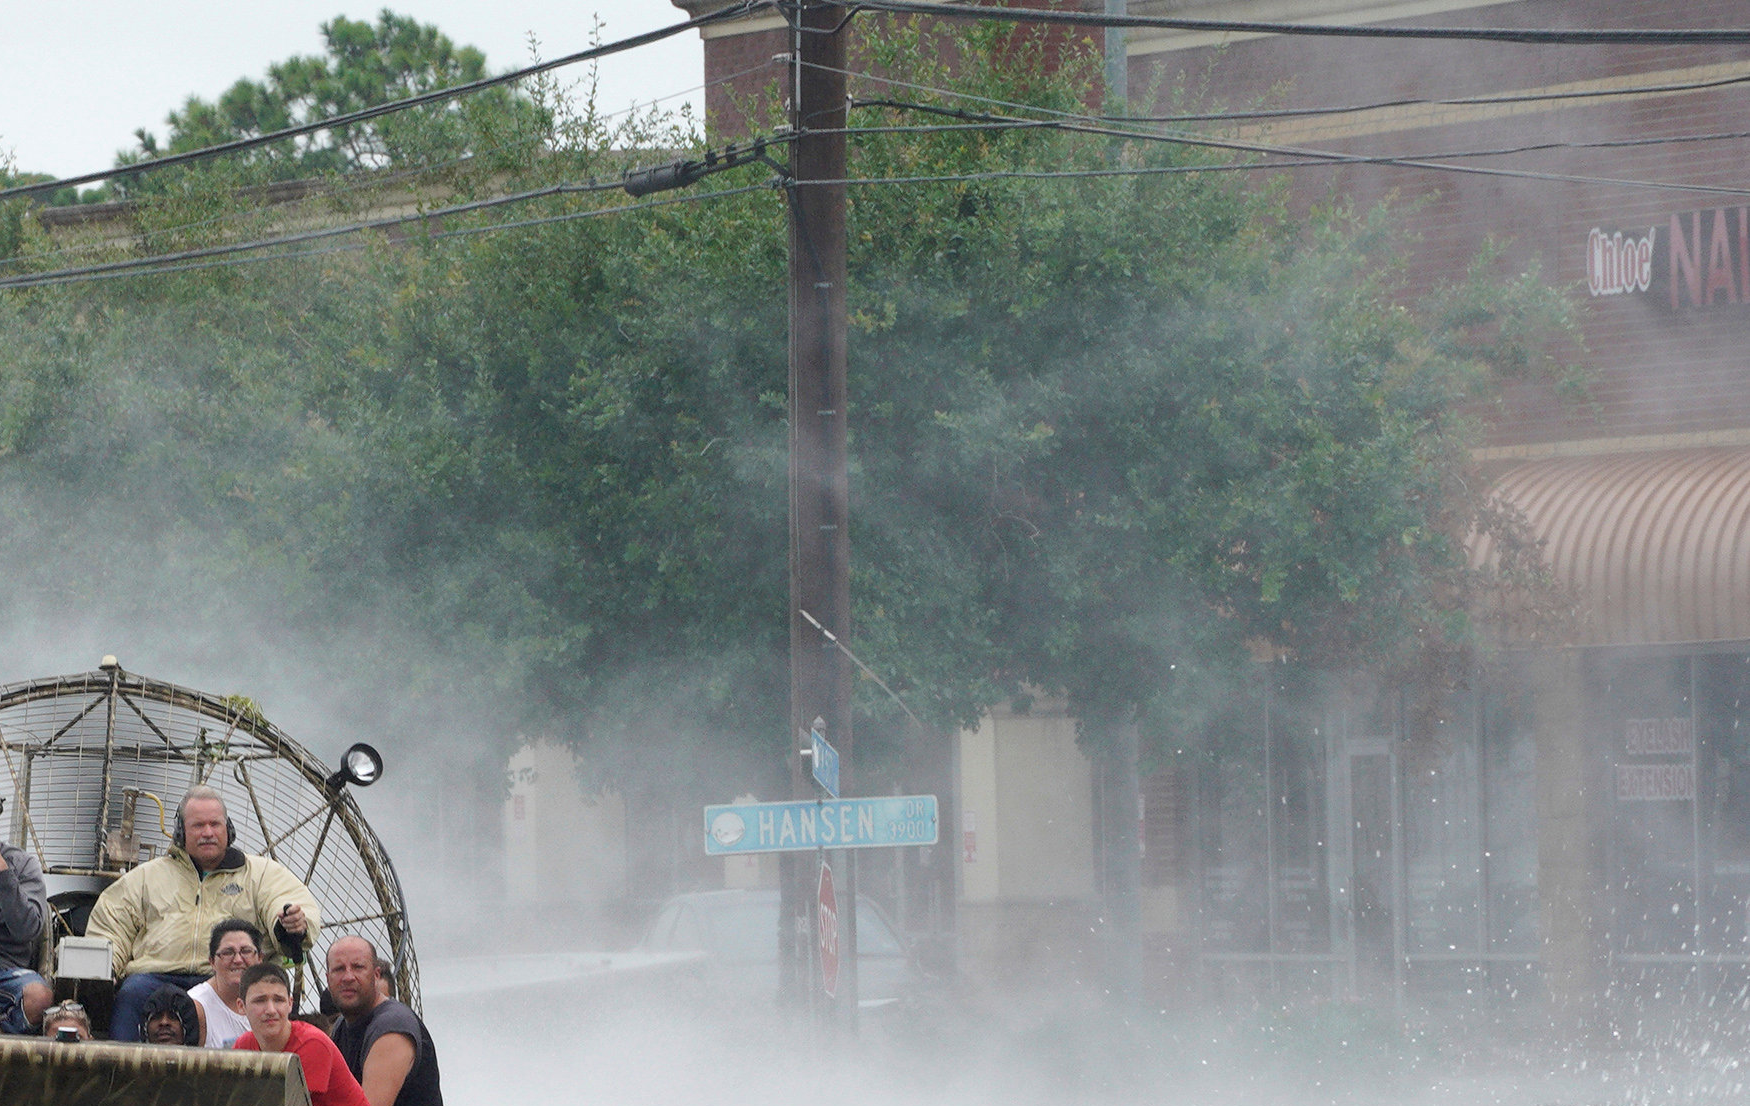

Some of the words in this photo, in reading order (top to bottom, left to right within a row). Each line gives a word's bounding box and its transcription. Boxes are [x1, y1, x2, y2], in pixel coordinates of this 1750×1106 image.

[758, 803, 875, 847] HANSEN
[906, 799, 925, 819] DR
[888, 819, 926, 842] 3900
[820, 901, 838, 956] STOP
